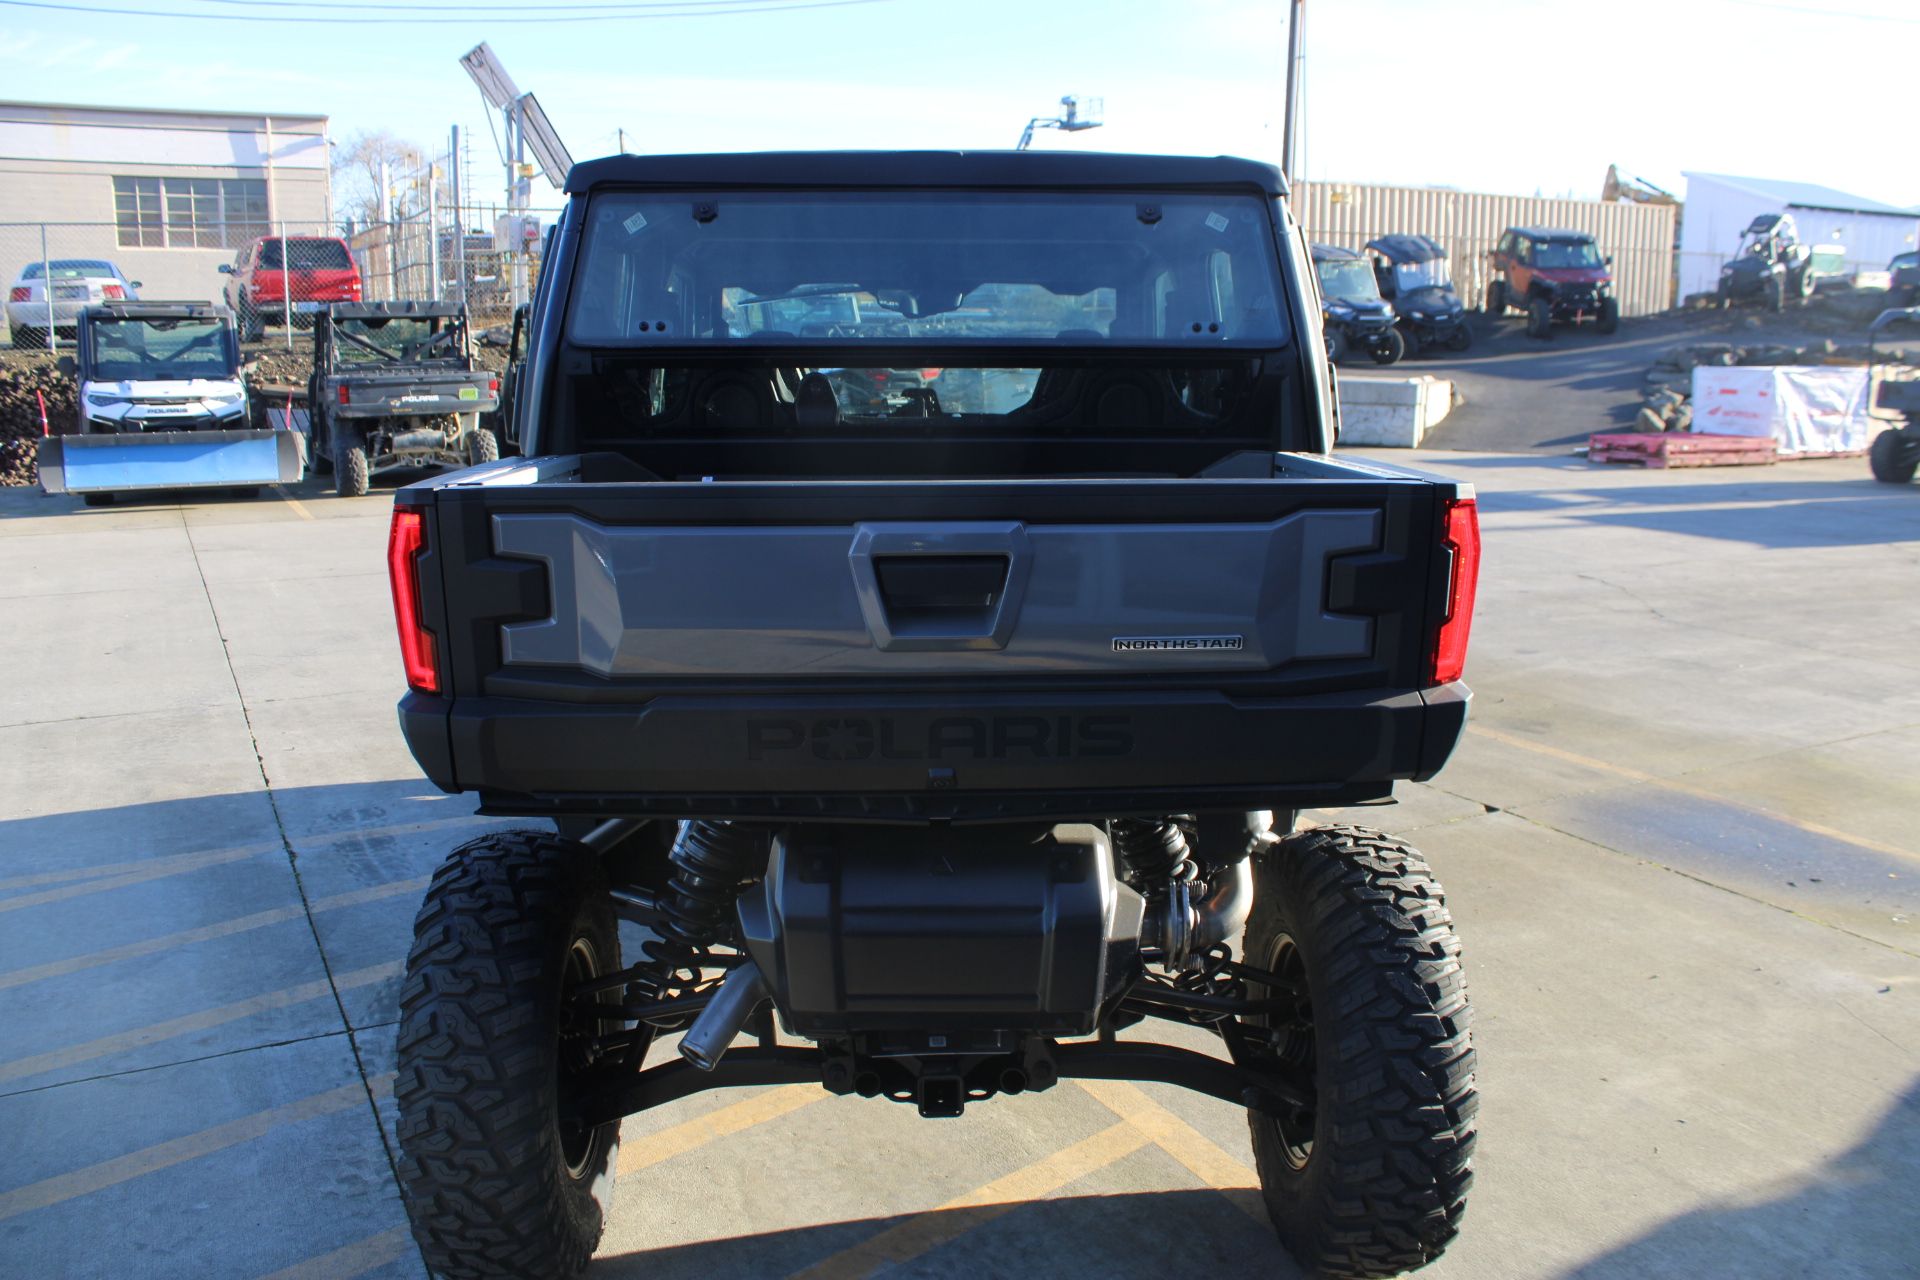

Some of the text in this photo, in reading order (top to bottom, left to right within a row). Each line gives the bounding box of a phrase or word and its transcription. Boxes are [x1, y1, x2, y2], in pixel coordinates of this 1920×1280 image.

[401, 394, 440, 402] POLARIS
[1117, 639, 1238, 650] NORTHSTAR
[747, 715, 1135, 761] POLARIS
